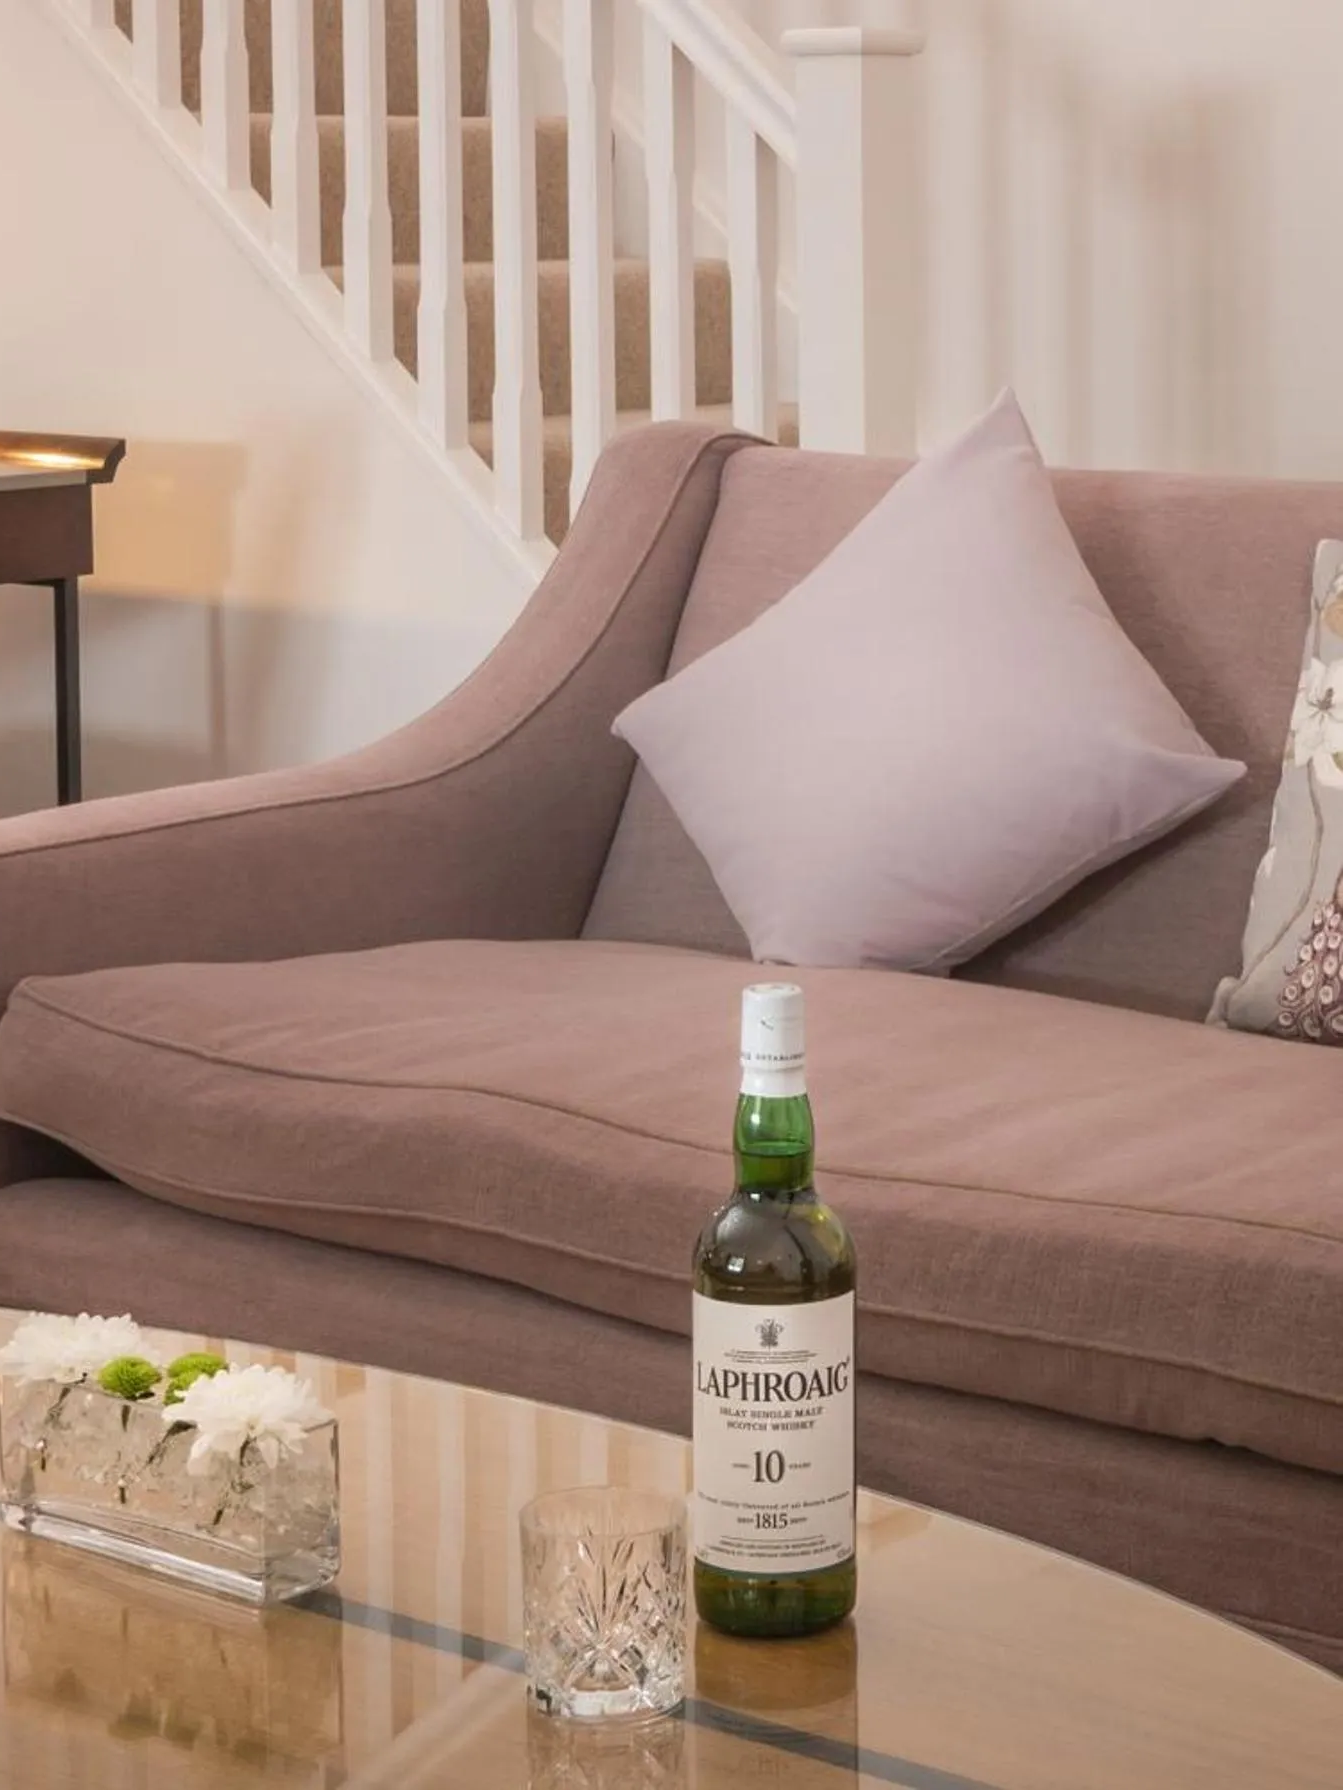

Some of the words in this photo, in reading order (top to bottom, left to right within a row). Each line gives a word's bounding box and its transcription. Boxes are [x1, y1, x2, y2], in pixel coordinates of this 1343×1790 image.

[697, 1360, 849, 1402] LAPHROAIG
[719, 1406, 748, 1418] ISLAY
[750, 1408, 792, 1419] SINGLE
[794, 1406, 825, 1418] MALT
[726, 1420, 768, 1431] SCOTCH
[770, 1420, 816, 1431] WHISKY
[753, 1449, 786, 1484] 10
[755, 1512, 789, 1529] 1815
